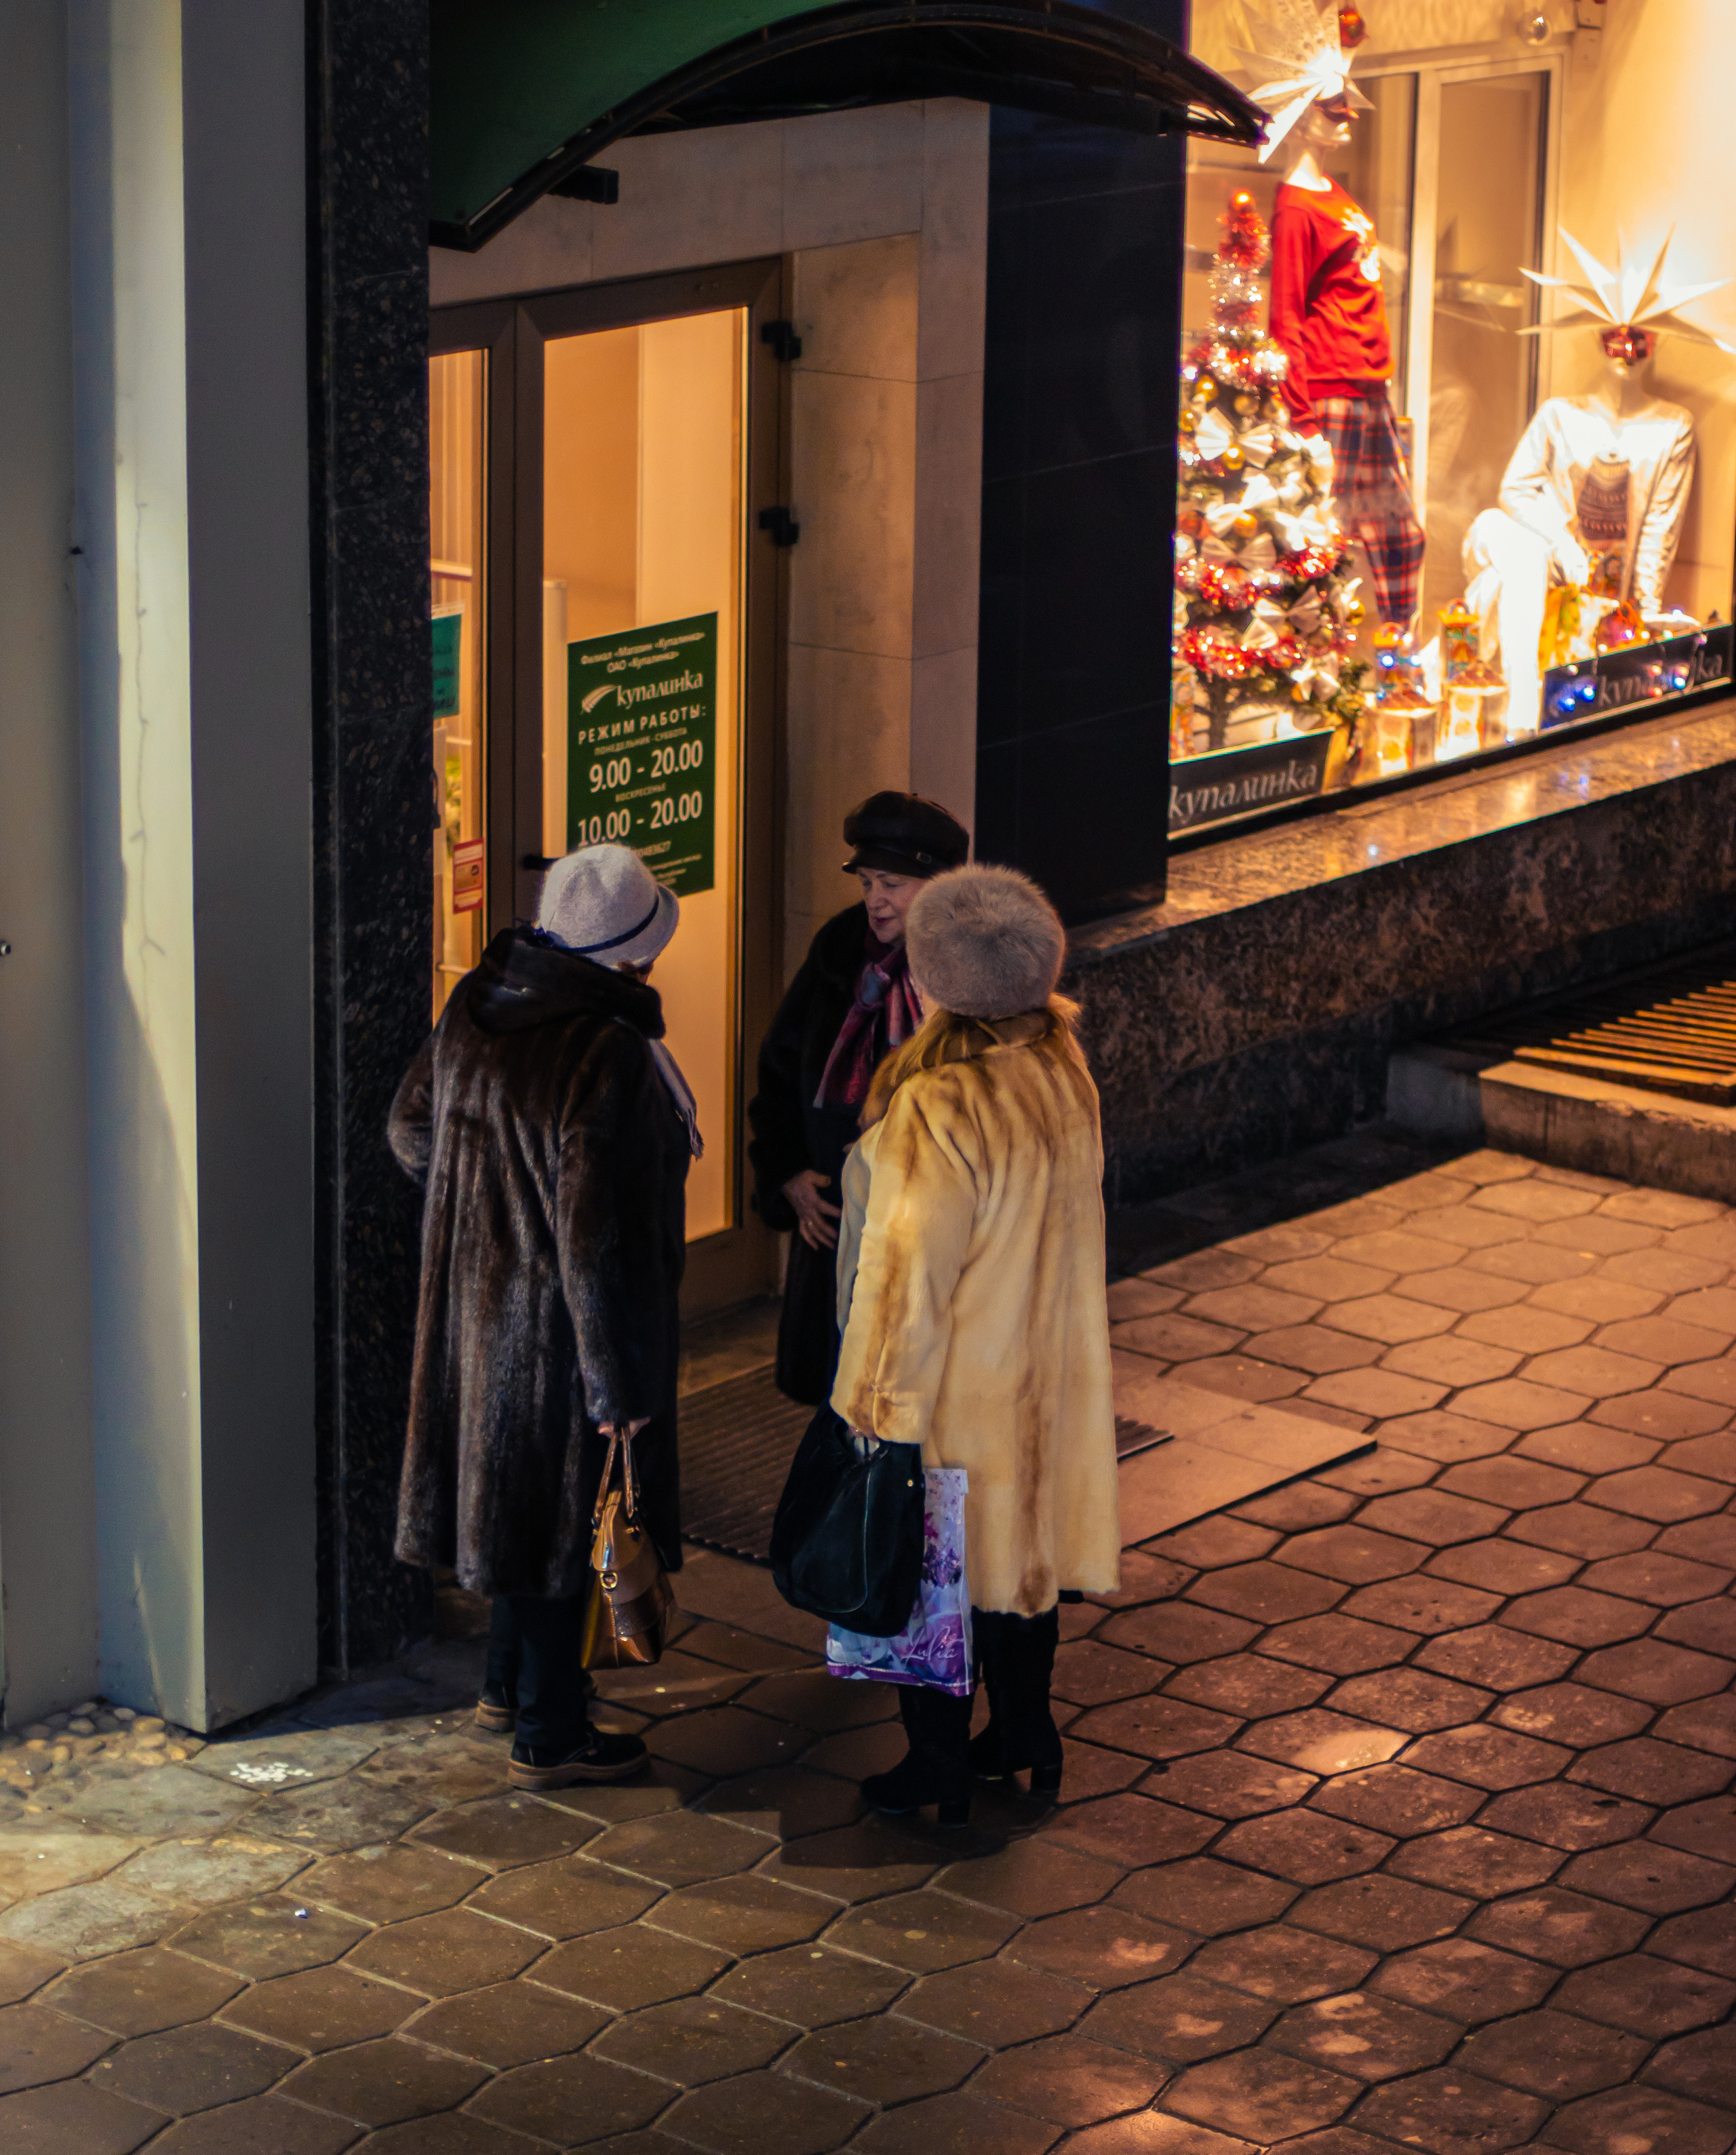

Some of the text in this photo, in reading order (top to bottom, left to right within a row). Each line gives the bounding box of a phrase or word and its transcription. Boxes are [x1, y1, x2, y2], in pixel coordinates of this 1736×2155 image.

[607, 659, 627, 673] ОАО
[578, 703, 706, 745] РЕЖИМ РАБОТЫ:
[589, 757, 631, 793] 9.00
[650, 739, 703, 778] 20.00
[578, 809, 631, 848] 10.00
[650, 790, 703, 829] 20.00
